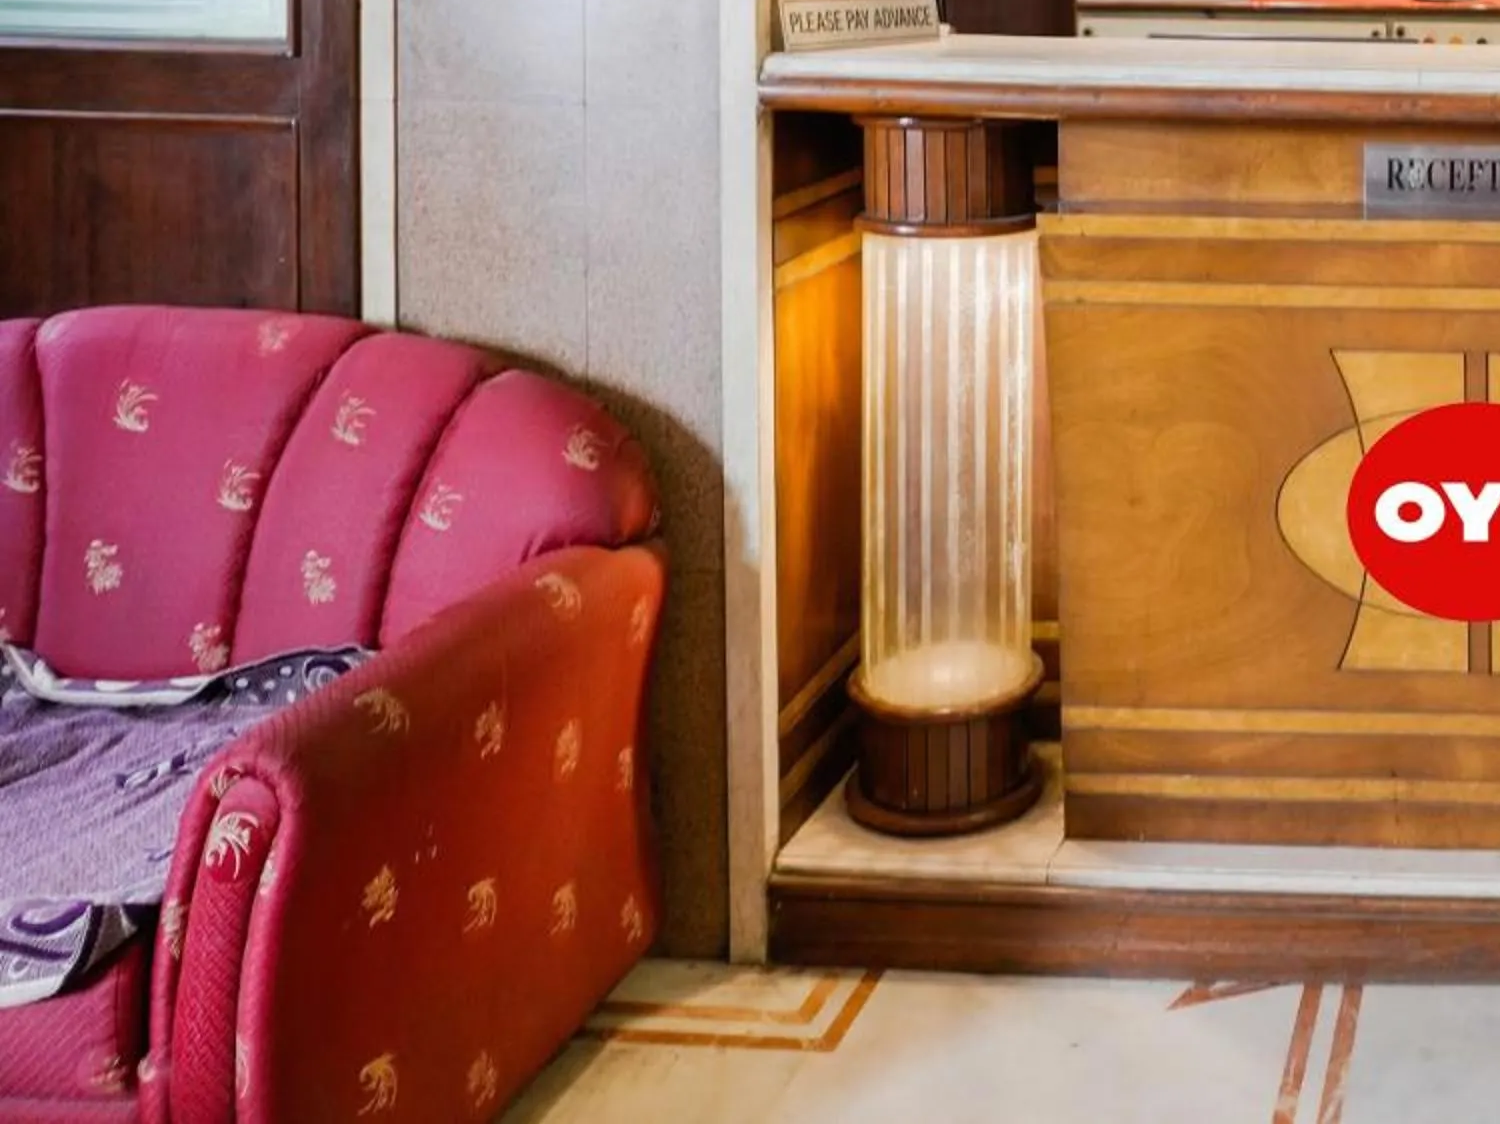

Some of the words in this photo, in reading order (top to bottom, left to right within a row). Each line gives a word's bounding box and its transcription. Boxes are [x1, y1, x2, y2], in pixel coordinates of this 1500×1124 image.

[789, 9, 844, 33] PLEASE
[845, 7, 869, 29] PAY
[873, 6, 932, 28] ADVANCE
